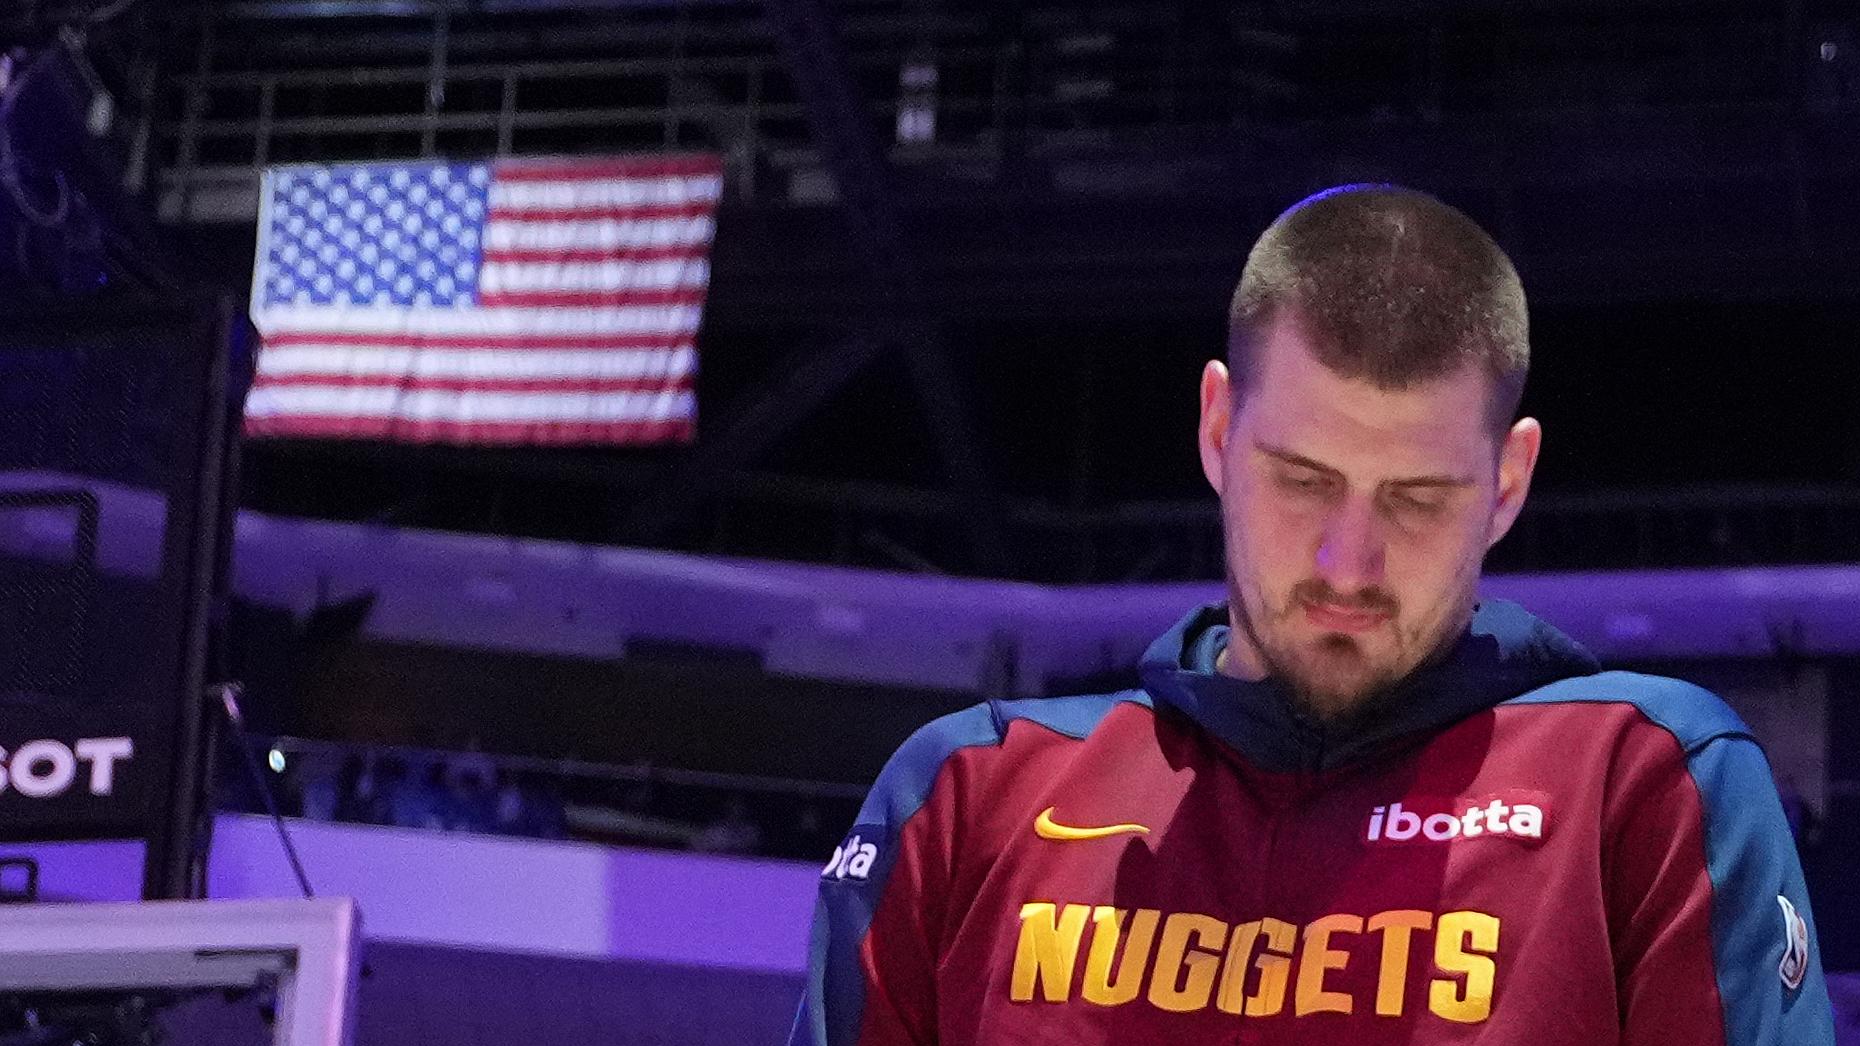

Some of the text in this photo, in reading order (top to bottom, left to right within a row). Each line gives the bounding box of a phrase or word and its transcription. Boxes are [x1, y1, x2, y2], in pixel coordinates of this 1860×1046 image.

[0, 736, 134, 798] OT
[1367, 799, 1543, 842] ibotta
[1009, 902, 1500, 1024] NUGGETS
